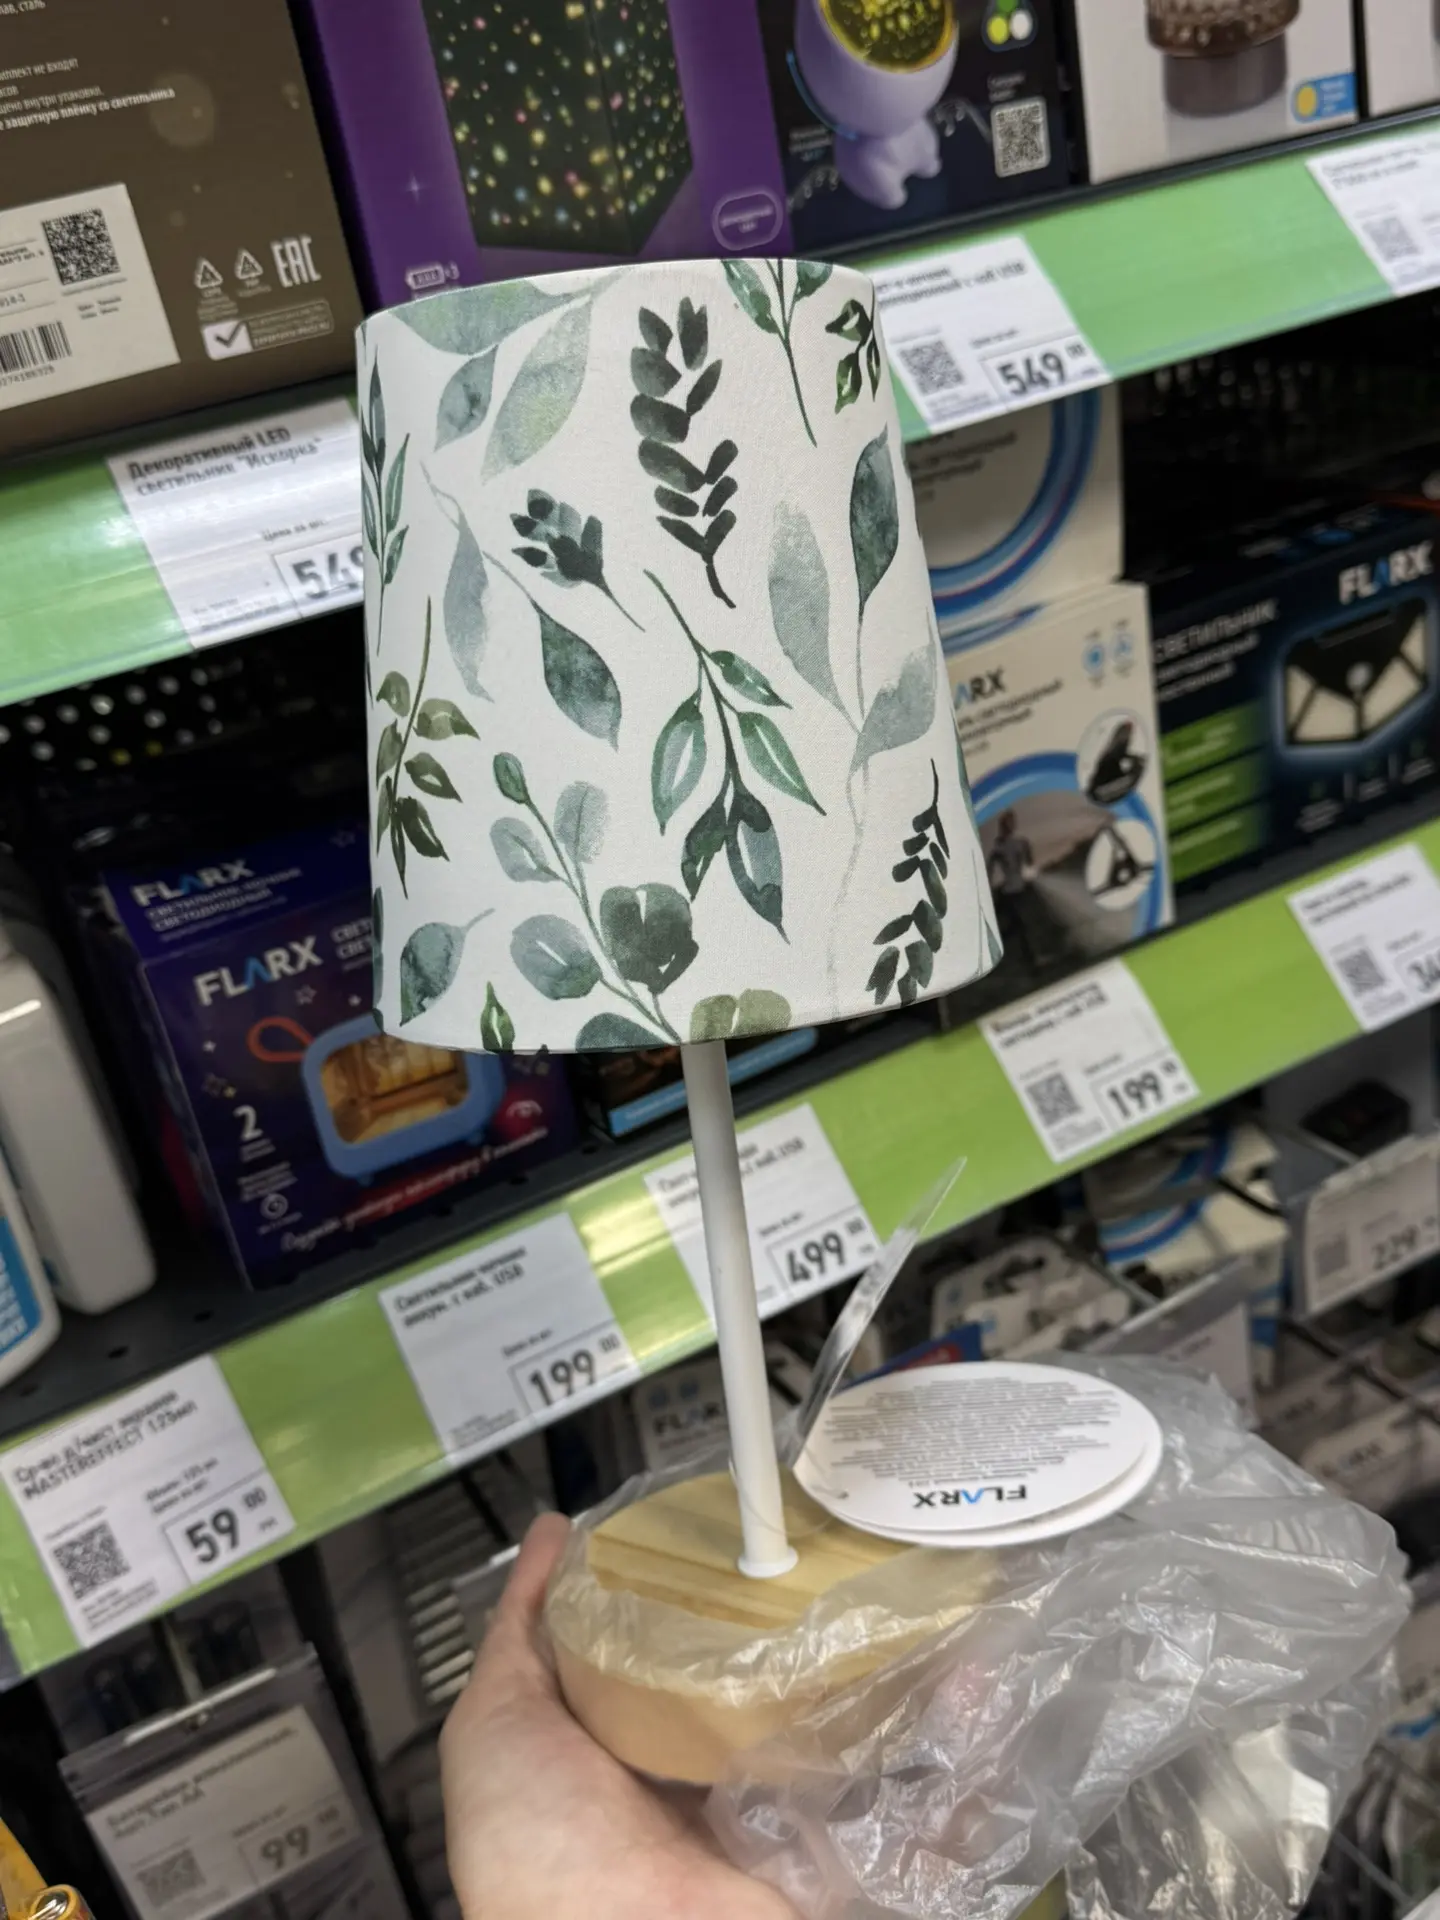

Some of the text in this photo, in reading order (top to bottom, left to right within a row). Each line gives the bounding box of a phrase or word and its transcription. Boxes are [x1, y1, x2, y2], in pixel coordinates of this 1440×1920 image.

[33, 63, 46, 75] не
[46, 57, 79, 74] входят
[5, 111, 60, 129] защитную
[60, 103, 98, 120] плёнку
[98, 100, 110, 112] со
[111, 88, 176, 109] светильника
[23, 95, 58, 110] внутри
[996, 351, 1066, 397] 549
[127, 426, 291, 481] Декоративный LED
[137, 437, 322, 497] светильник "Искорка"
[1338, 541, 1434, 605] FLARX
[131, 860, 254, 907] FLARX
[193, 935, 323, 1006] FLARX
[1107, 1071, 1165, 1120] 199
[233, 1104, 263, 1141] 2
[786, 1231, 847, 1283] 499
[529, 1350, 596, 1407] 199
[913, 1484, 1028, 1509] FLARX
[184, 1485, 268, 1564] 59 00
[260, 1824, 310, 1870] 99
